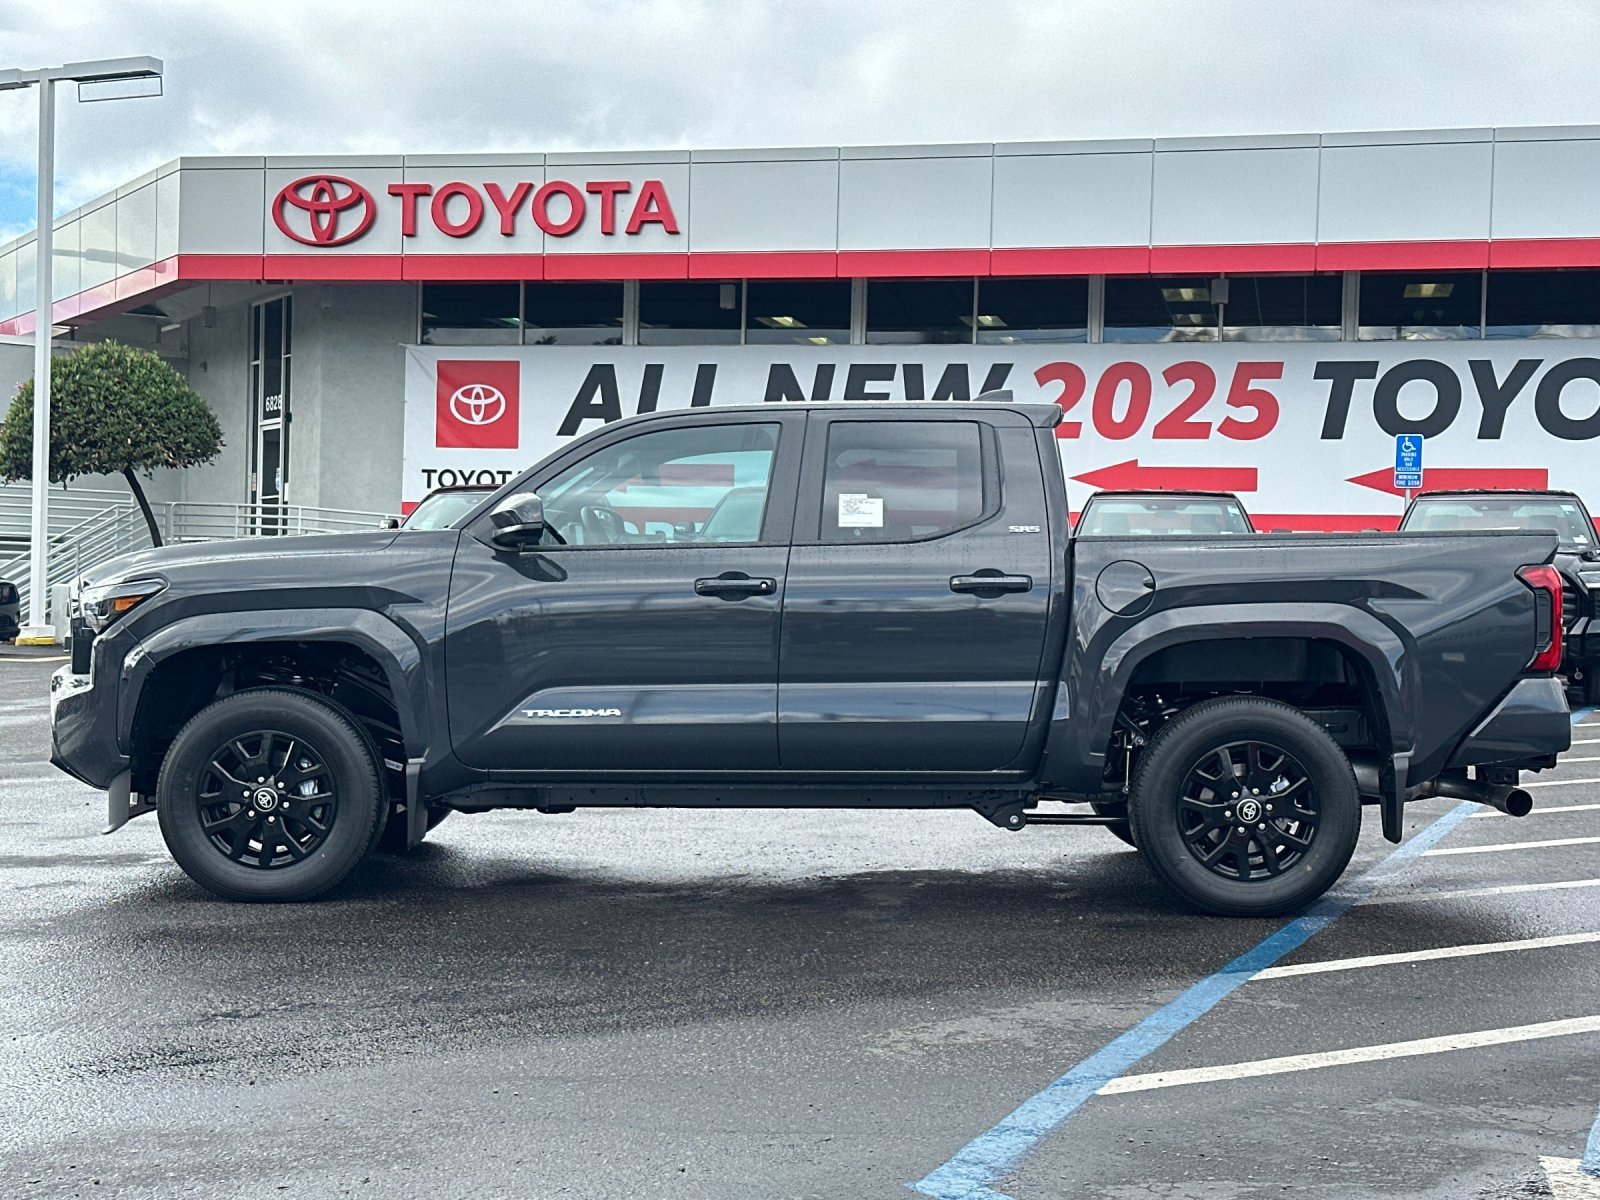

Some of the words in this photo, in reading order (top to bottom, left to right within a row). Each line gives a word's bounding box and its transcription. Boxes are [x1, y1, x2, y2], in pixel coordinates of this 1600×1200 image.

[388, 180, 680, 238] TOYOTA
[1033, 361, 1285, 440] 2025
[421, 469, 522, 489] TOYOT
[521, 708, 621, 717] TACOMA
